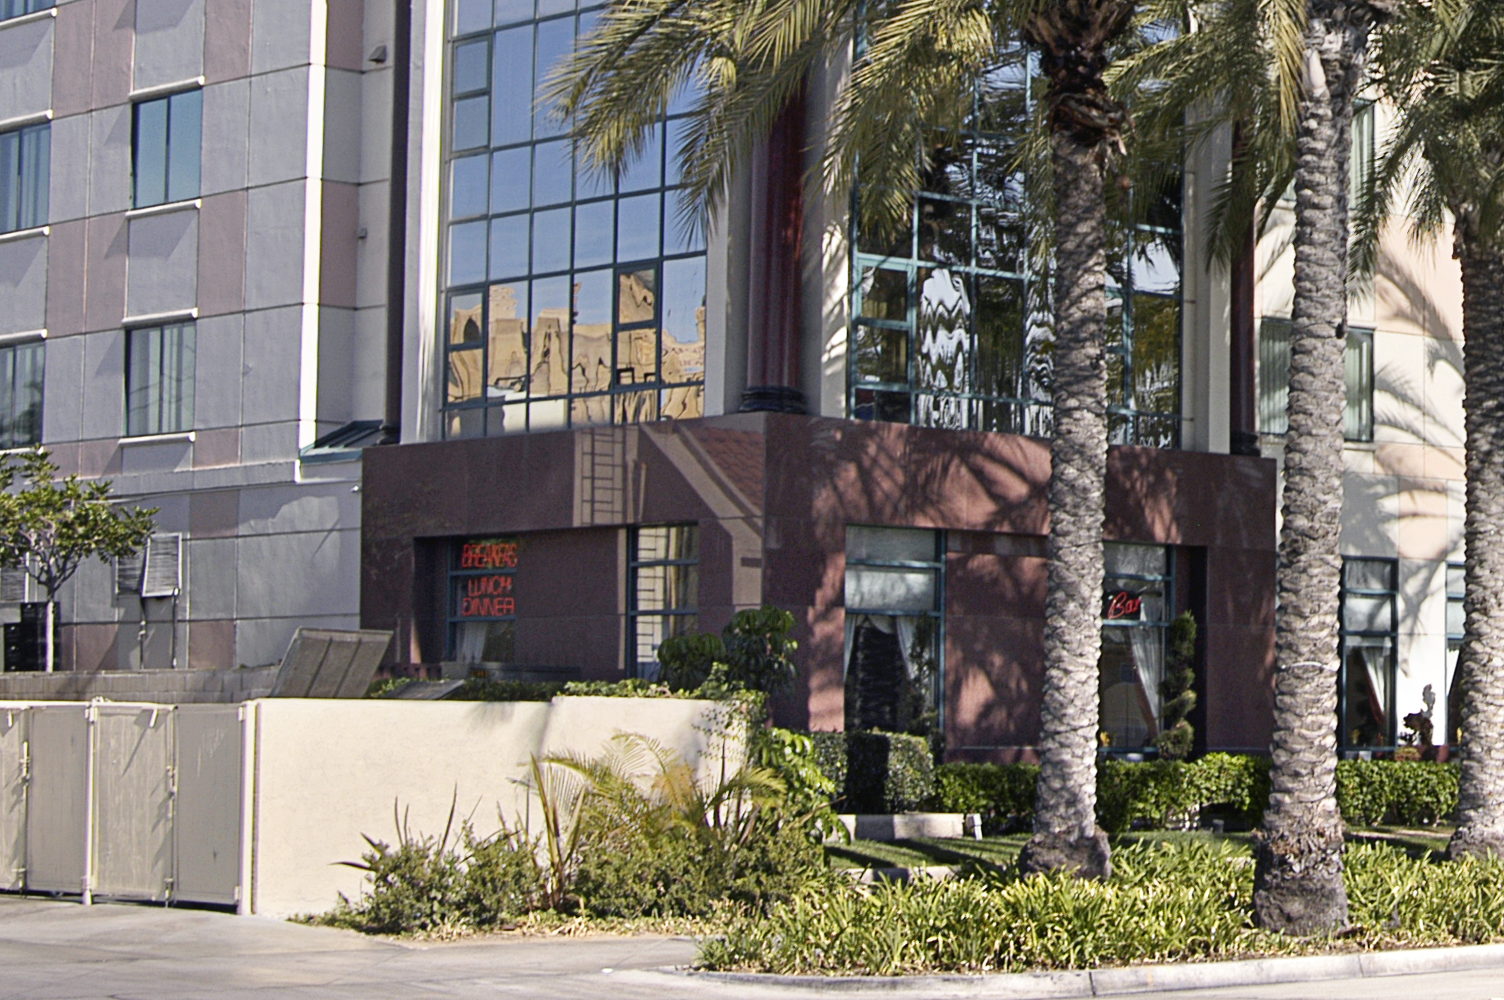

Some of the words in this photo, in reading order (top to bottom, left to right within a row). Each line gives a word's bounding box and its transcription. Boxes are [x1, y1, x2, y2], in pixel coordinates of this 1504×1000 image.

[462, 543, 518, 568] BREAKFAS
[468, 575, 513, 597] LUNCH
[462, 597, 516, 616] DINNER
[1107, 591, 1142, 620] Bar
